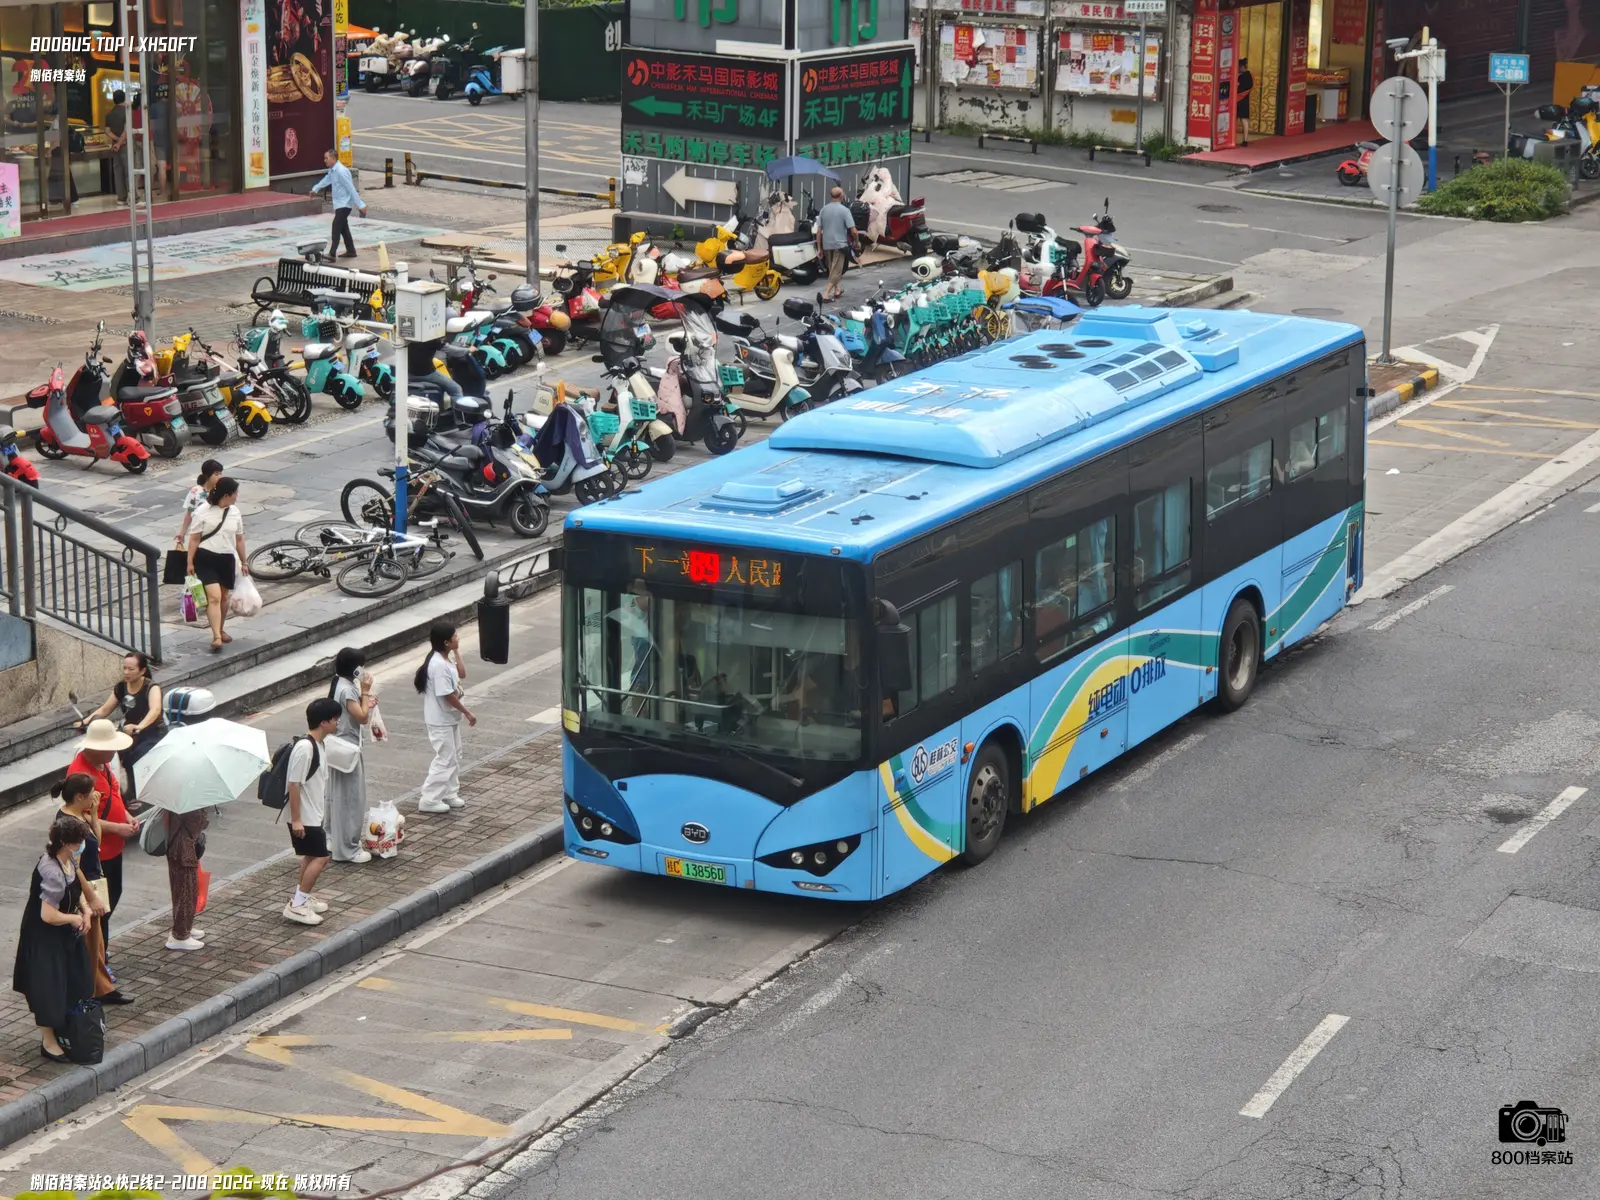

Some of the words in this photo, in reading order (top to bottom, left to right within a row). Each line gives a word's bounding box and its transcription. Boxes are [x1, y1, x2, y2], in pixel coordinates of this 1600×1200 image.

[650, 60, 779, 92] 中影禾马国际影城
[818, 58, 899, 84] 中影禾马国际影城
[623, 130, 776, 169] 禾马购物停车场
[1087, 675, 1126, 720] 纯电动
[684, 827, 706, 839] BYD
